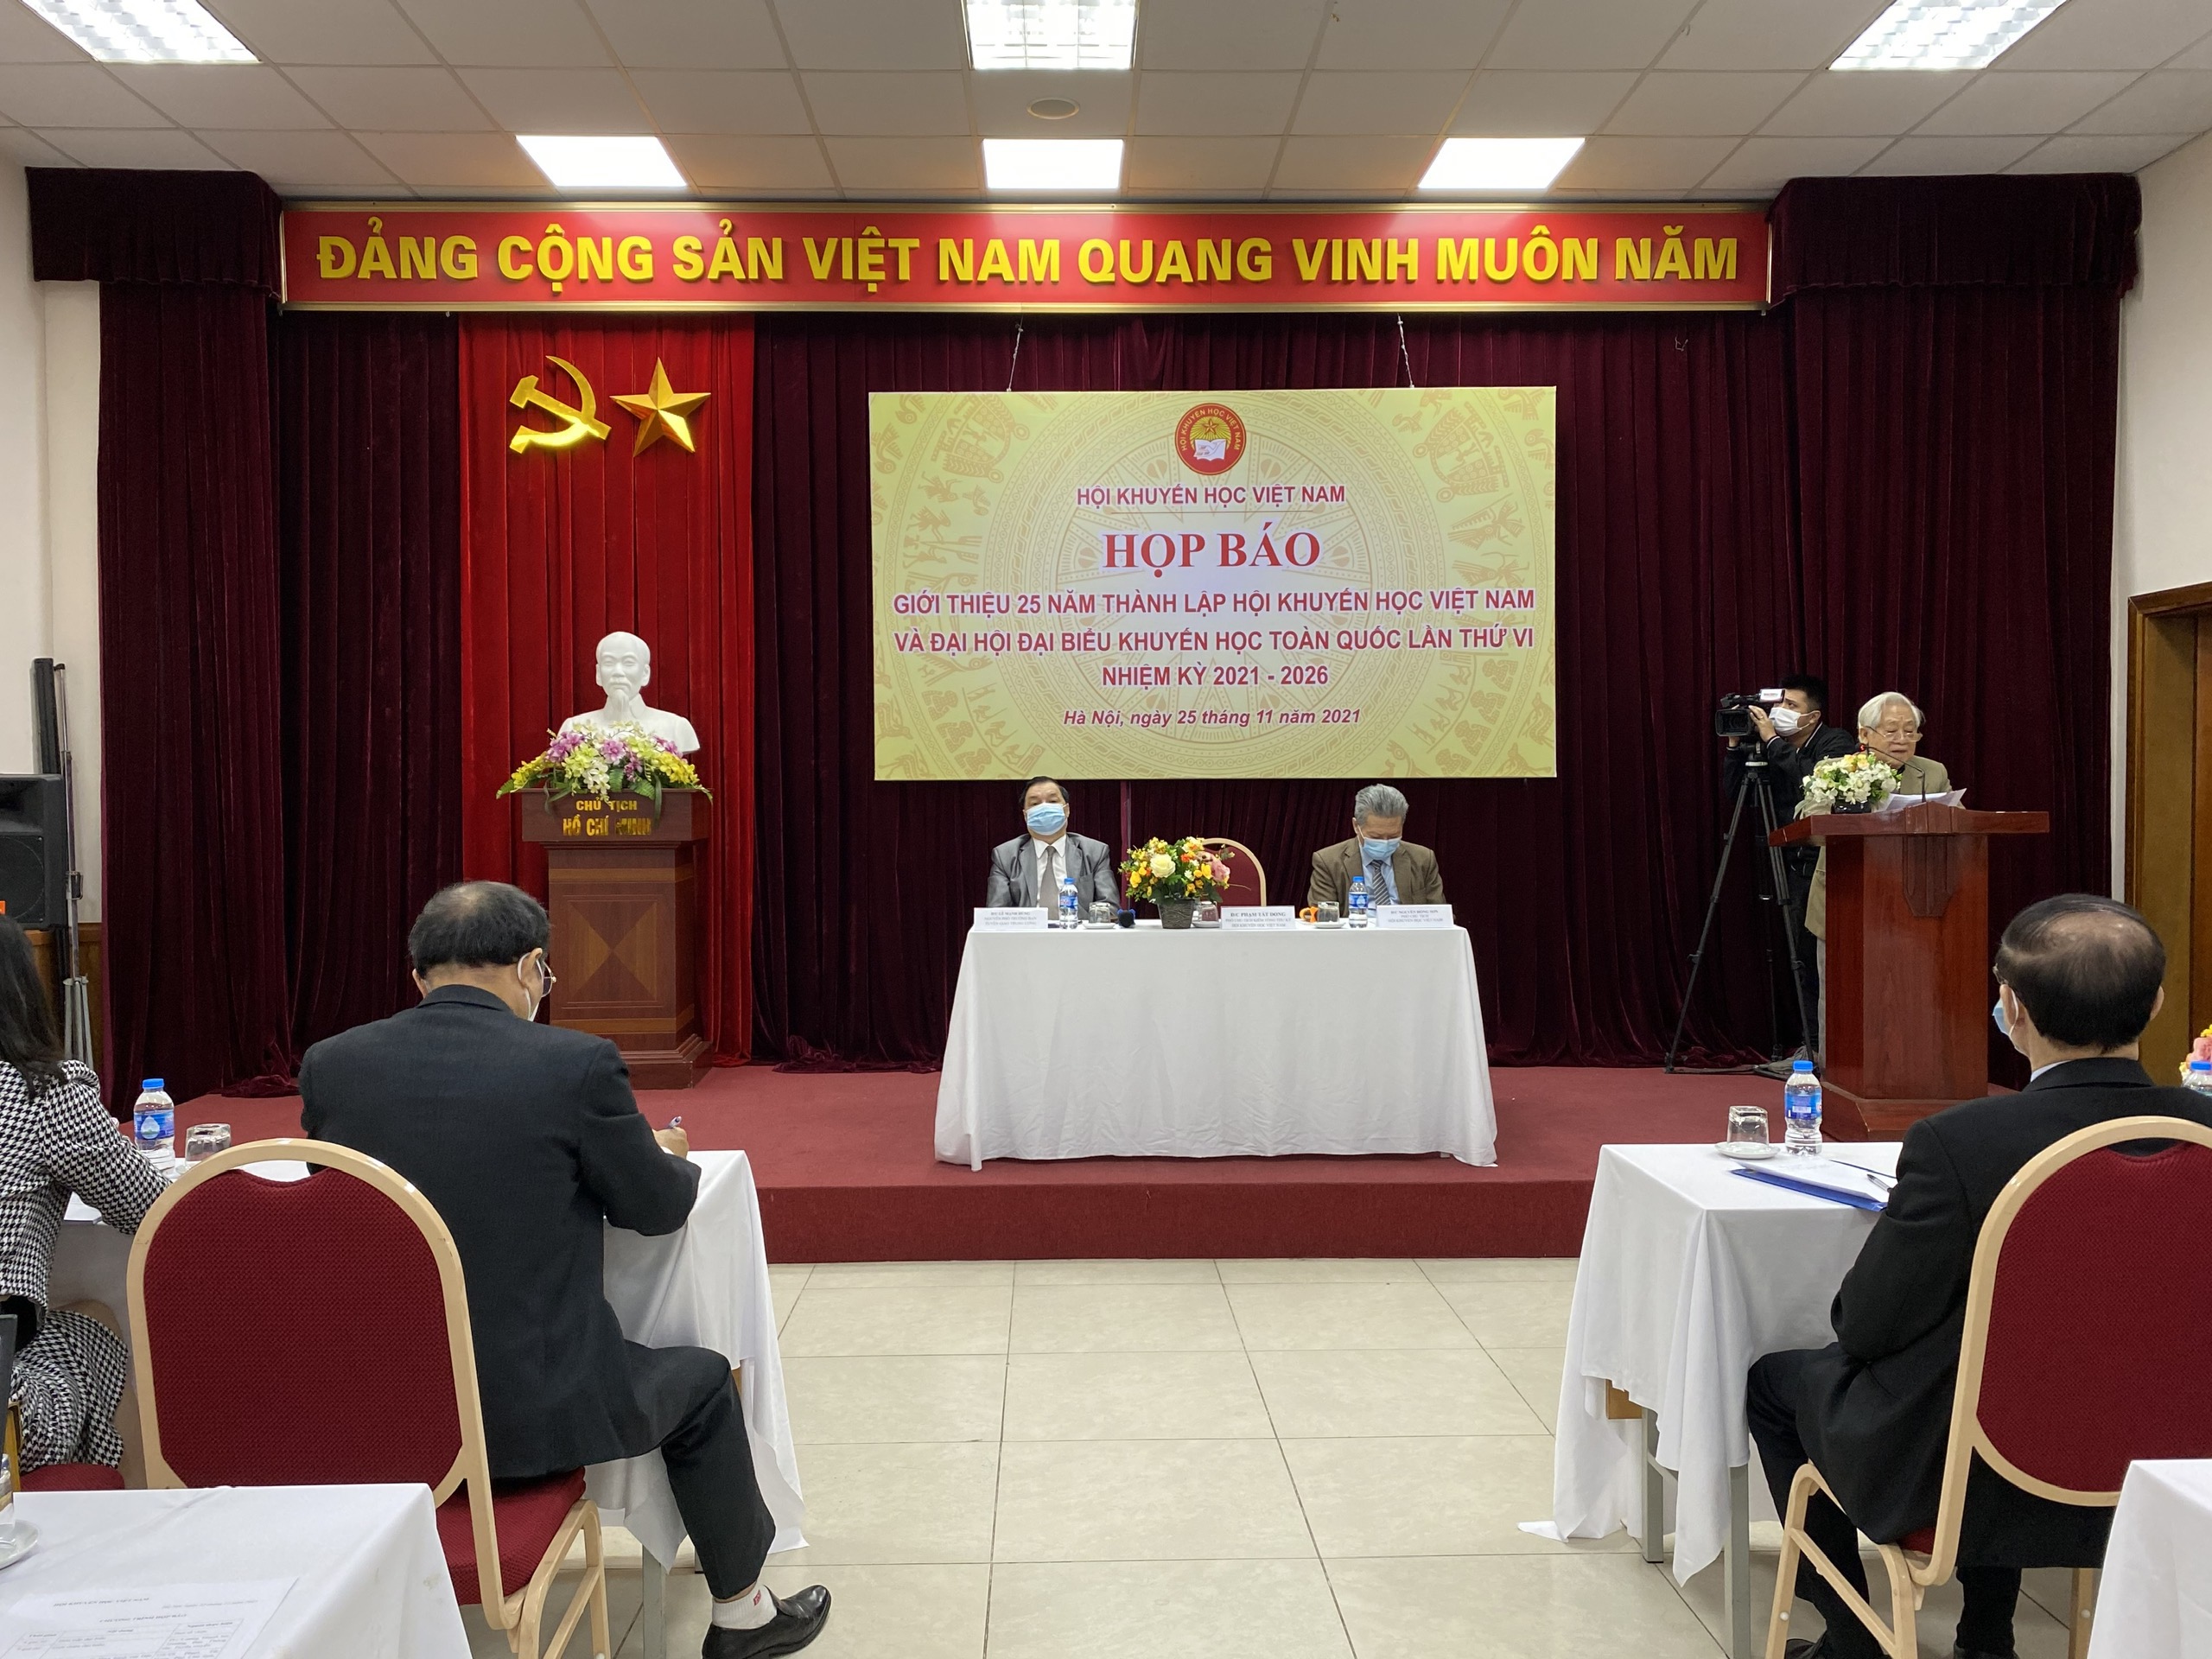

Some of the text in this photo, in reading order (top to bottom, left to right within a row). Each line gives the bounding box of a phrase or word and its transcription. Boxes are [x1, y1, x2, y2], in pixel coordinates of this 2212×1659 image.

[317, 216, 1738, 293] ĐẢNG CỘNG SẢN VIỆT NAM QUANG VINH MUÔN NĂM
[1077, 483, 1345, 509] HỘI KHUYẾN HỌC VIỆT NAM
[1103, 521, 1321, 578] HỌP BÁO
[893, 588, 1535, 618] GIỚI THIỆU 25 NĂM THÀNH LẬP HỘI KHUYẾN HỌC VIỆT NAM
[893, 624, 1534, 656] VÀ ĐẠI HỘI ĐẠI BIỂU KHUYẾN HỌC TOÀN QUỐC LẦN THỨ VI
[1103, 664, 1170, 690] NHIỆM
[1178, 661, 1206, 685] KỲ
[1213, 665, 1260, 685] 2021
[1281, 665, 1329, 684] 2026
[1064, 709, 1361, 728] Hà Nội, ngày 25 tháng 11 năm 2021
[575, 797, 638, 812] CHỦ TỊCH
